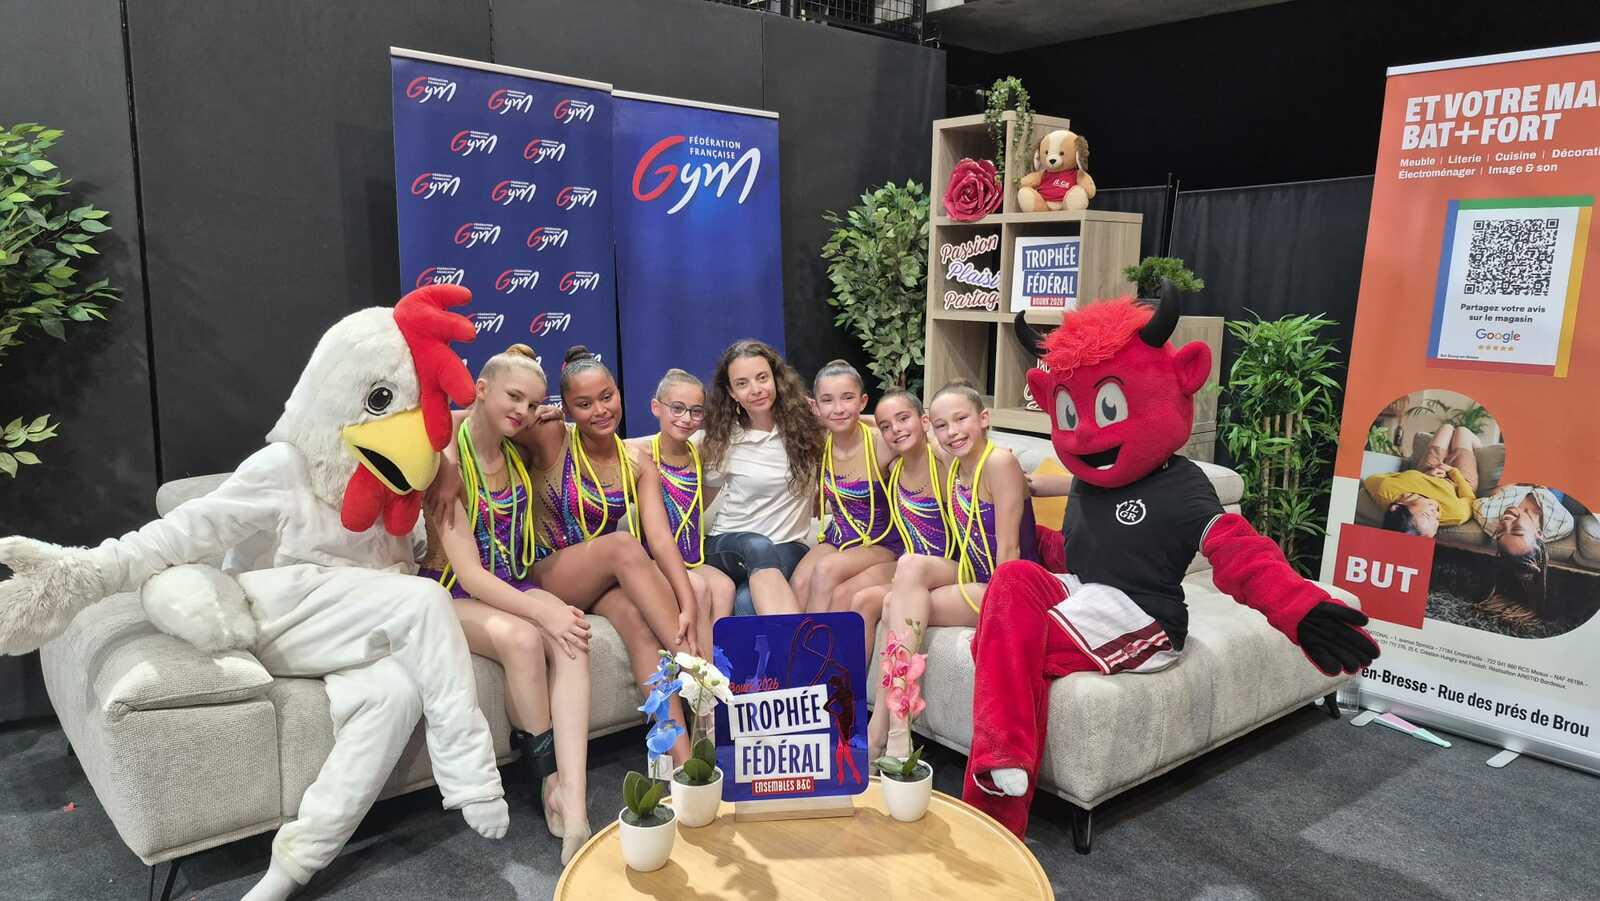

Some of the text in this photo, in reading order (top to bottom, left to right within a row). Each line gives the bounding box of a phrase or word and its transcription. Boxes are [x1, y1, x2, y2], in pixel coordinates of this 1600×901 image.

[1405, 80, 1600, 122] ET VOTRE MA
[689, 136, 741, 150] FÉDÉRATION
[690, 148, 735, 160] FRANÇAISE
[1400, 157, 1436, 167] Meuble
[1448, 154, 1481, 164] Literie
[1495, 151, 1537, 161] Cuisine
[632, 135, 761, 214] Gym
[1398, 168, 1476, 179] Électroménager
[1488, 164, 1523, 175] Image
[1536, 164, 1558, 172] son
[941, 234, 998, 264] Passion
[1025, 244, 1076, 268] TROPHÉE
[946, 261, 1000, 290] Plaisi
[1026, 271, 1074, 295] FÉDÉRAL
[944, 289, 999, 311] Partag
[1460, 303, 1499, 312] Partagez
[1501, 304, 1525, 312] votre
[468, 313, 504, 334] ym
[1495, 315, 1533, 323] magasin
[1475, 328, 1520, 343] Google
[1345, 555, 1419, 593] BUT
[734, 690, 822, 733] TROPHÉE
[1437, 684, 1464, 704] Rue
[1468, 692, 1492, 711] des
[1495, 702, 1527, 721] prés
[1530, 709, 1549, 726] de
[1552, 714, 1590, 737] Brou
[742, 740, 824, 776] FÉDÉRAL
[754, 780, 795, 793] ENSEMBLES
